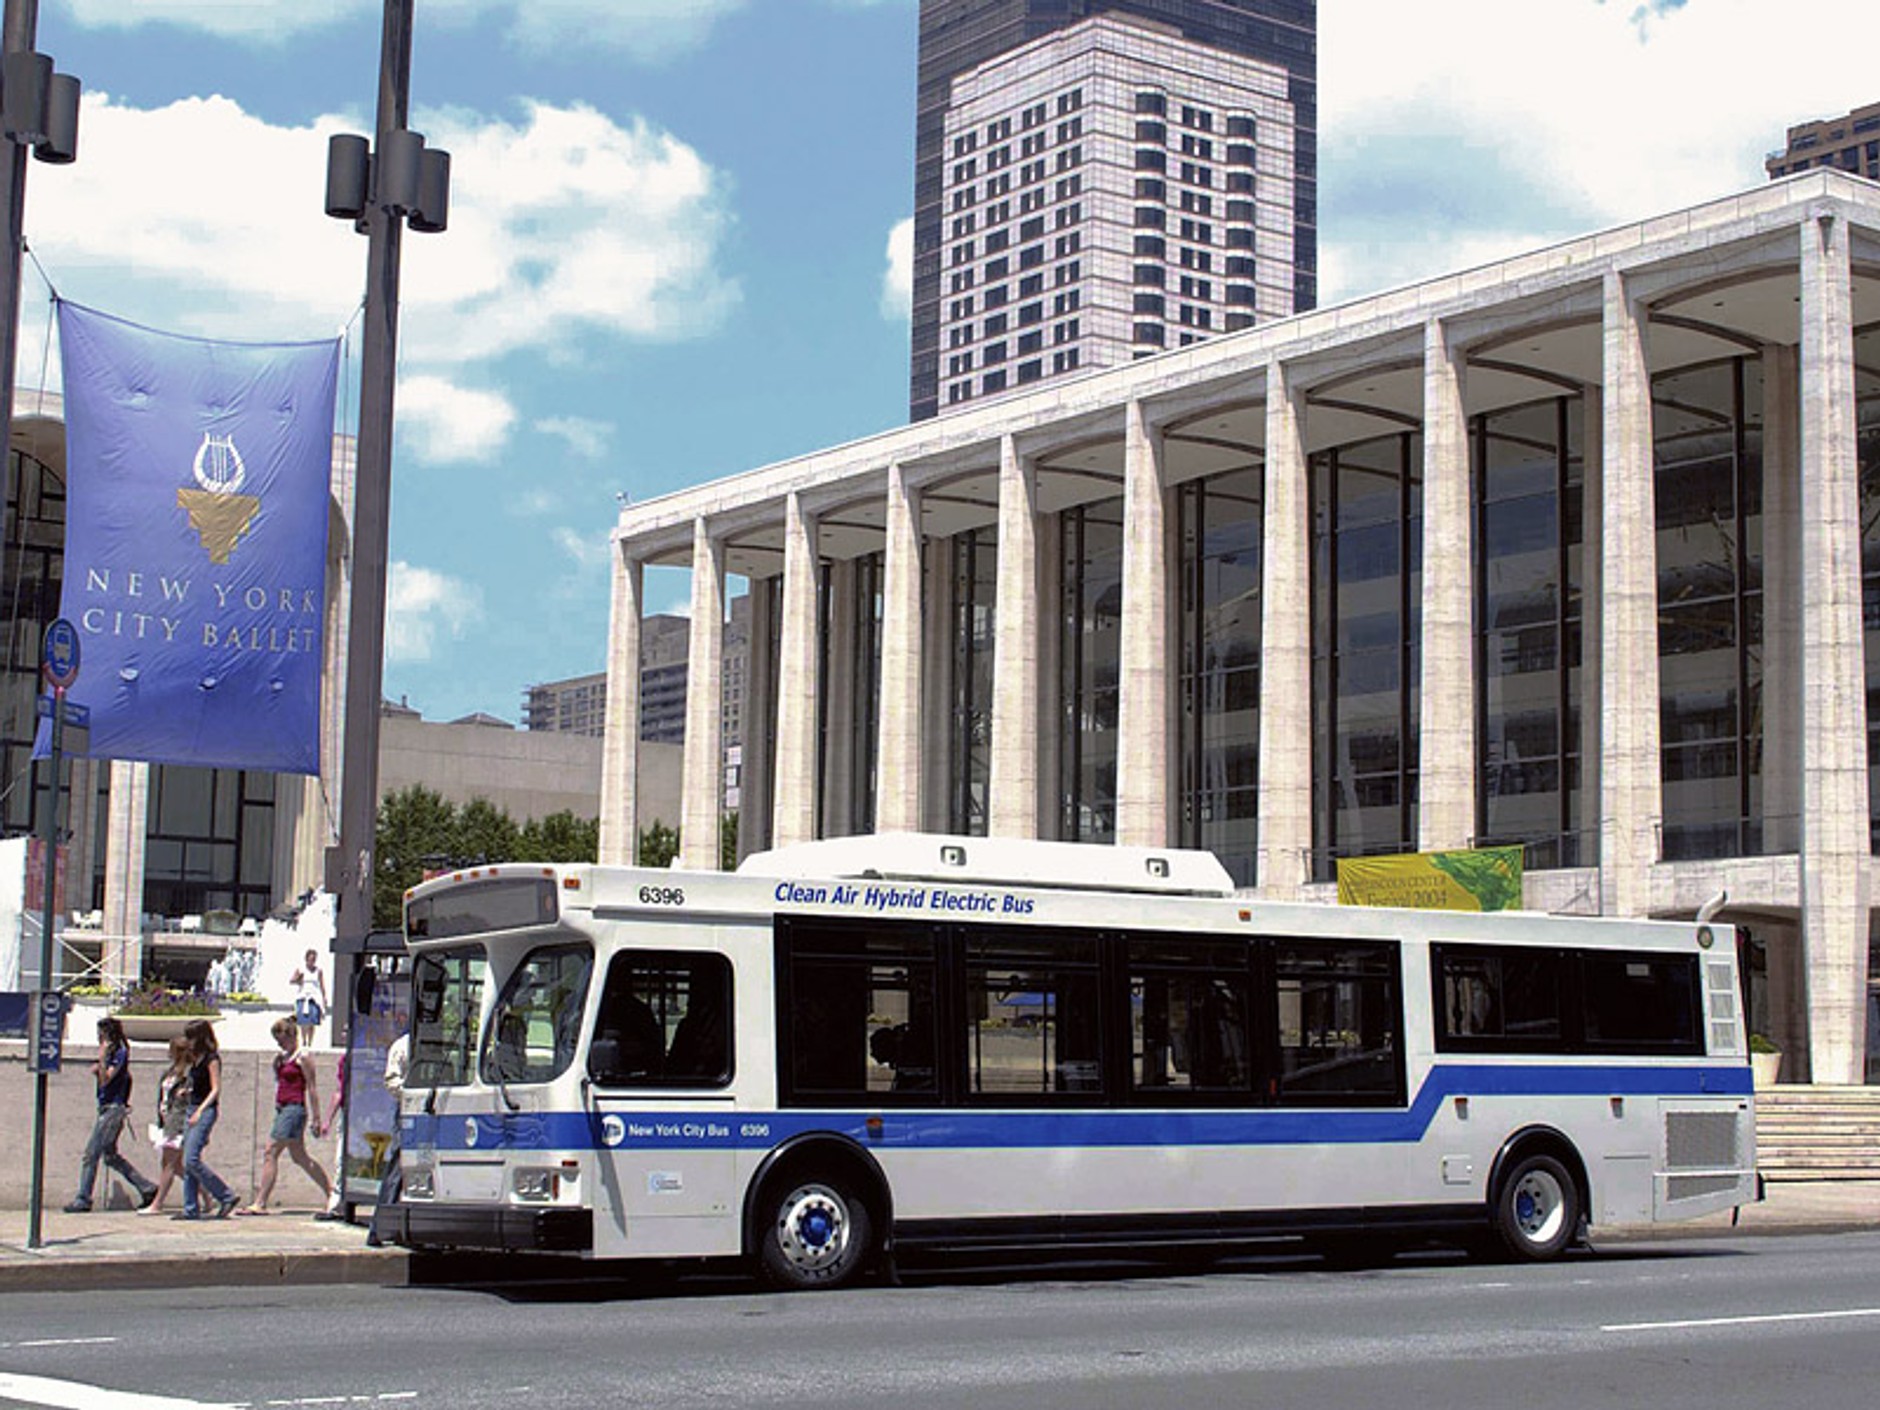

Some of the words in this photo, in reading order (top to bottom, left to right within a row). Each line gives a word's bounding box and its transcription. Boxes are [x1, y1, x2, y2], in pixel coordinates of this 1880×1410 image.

[86, 567, 192, 602] NEW
[213, 582, 315, 613] YORK
[82, 608, 181, 641] CITY
[202, 622, 315, 652] BALLET
[638, 886, 686, 905] 6396
[775, 882, 827, 903] Clean
[832, 885, 860, 906] Air
[864, 886, 925, 911] Hybrid
[930, 889, 996, 913] Electric
[1002, 894, 1035, 914] Bus
[1413, 889, 1448, 908] 2004
[628, 1124, 653, 1137] New
[655, 1123, 681, 1137] York
[683, 1123, 705, 1139] City
[707, 1123, 729, 1137] Bus
[740, 1123, 770, 1137] 6396
